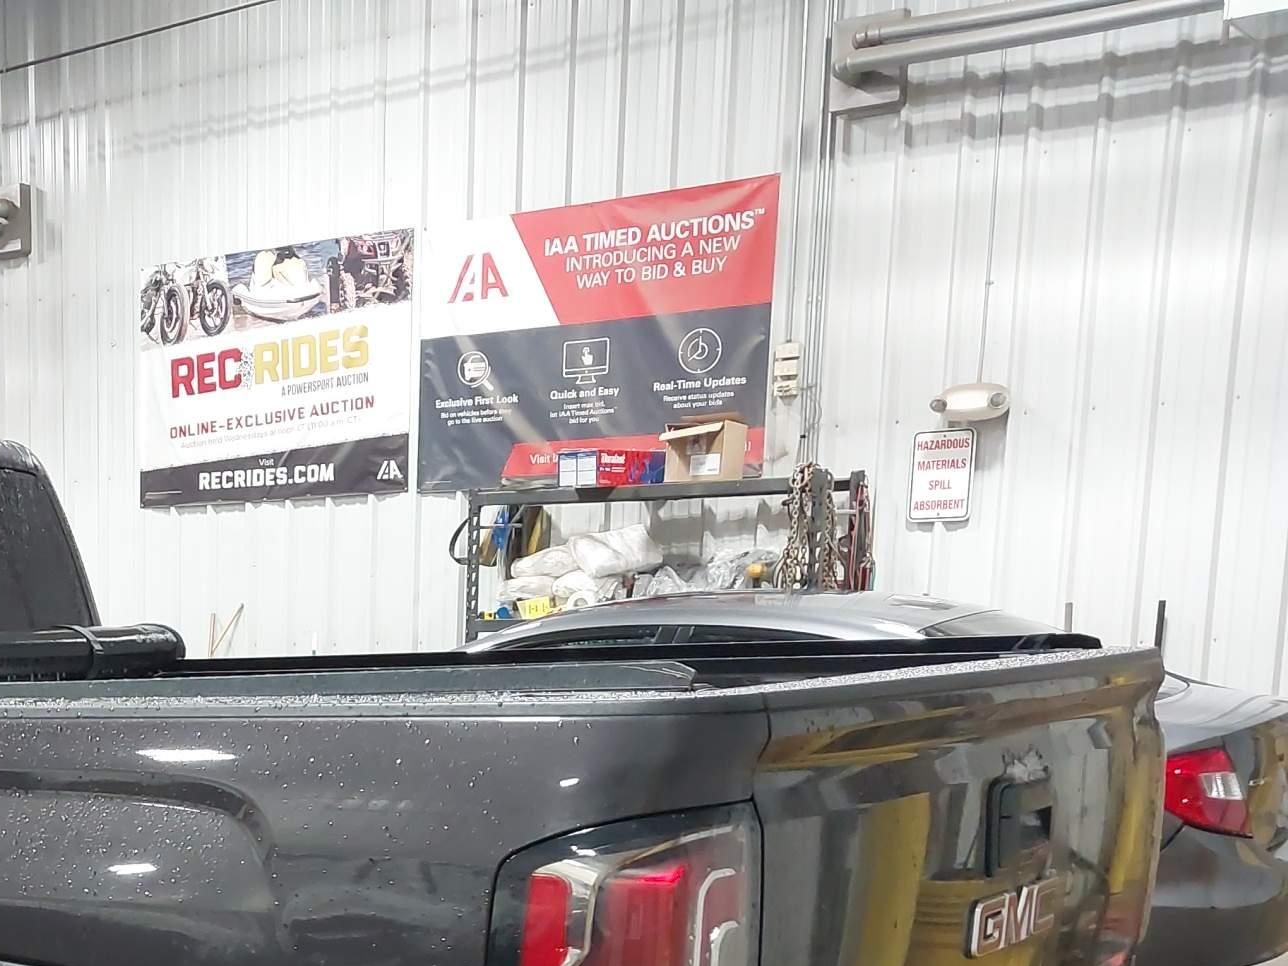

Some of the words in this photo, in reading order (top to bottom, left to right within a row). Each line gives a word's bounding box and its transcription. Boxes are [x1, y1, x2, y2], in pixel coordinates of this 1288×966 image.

[544, 235, 579, 256] IAA
[583, 226, 641, 252] TIMED
[565, 244, 676, 272] INTRODUCING
[681, 241, 694, 257] A
[699, 235, 741, 255] NEW
[576, 270, 611, 289] WAY
[615, 267, 636, 284] TO
[641, 264, 668, 281] BID
[673, 261, 686, 277] &
[691, 256, 727, 275] BUY
[170, 347, 244, 399] REC
[254, 324, 369, 386] RIDES
[281, 386, 287, 397] A
[287, 377, 334, 397] POWERSPORT
[336, 371, 369, 389] AUCTION
[653, 379, 701, 392] Real-Time
[703, 376, 747, 389] Updates
[435, 397, 473, 409] Exclusive
[474, 395, 494, 406] First
[496, 393, 519, 404] Look
[550, 389, 578, 400] Quick
[578, 388, 596, 398] and
[598, 386, 620, 397] Easy
[170, 407, 306, 439] ONLINE-EXCLUSIVE
[310, 395, 376, 418] AUCTION
[918, 438, 969, 450] HAZARDOUS
[258, 458, 274, 467] Visit
[530, 453, 551, 464] Visit
[918, 458, 966, 470] MATERIALS
[198, 463, 335, 491] RECRIDES.COM
[928, 479, 952, 490] SPILL
[913, 498, 966, 511] ABSORBENT
[969, 876, 1058, 958] GMC
